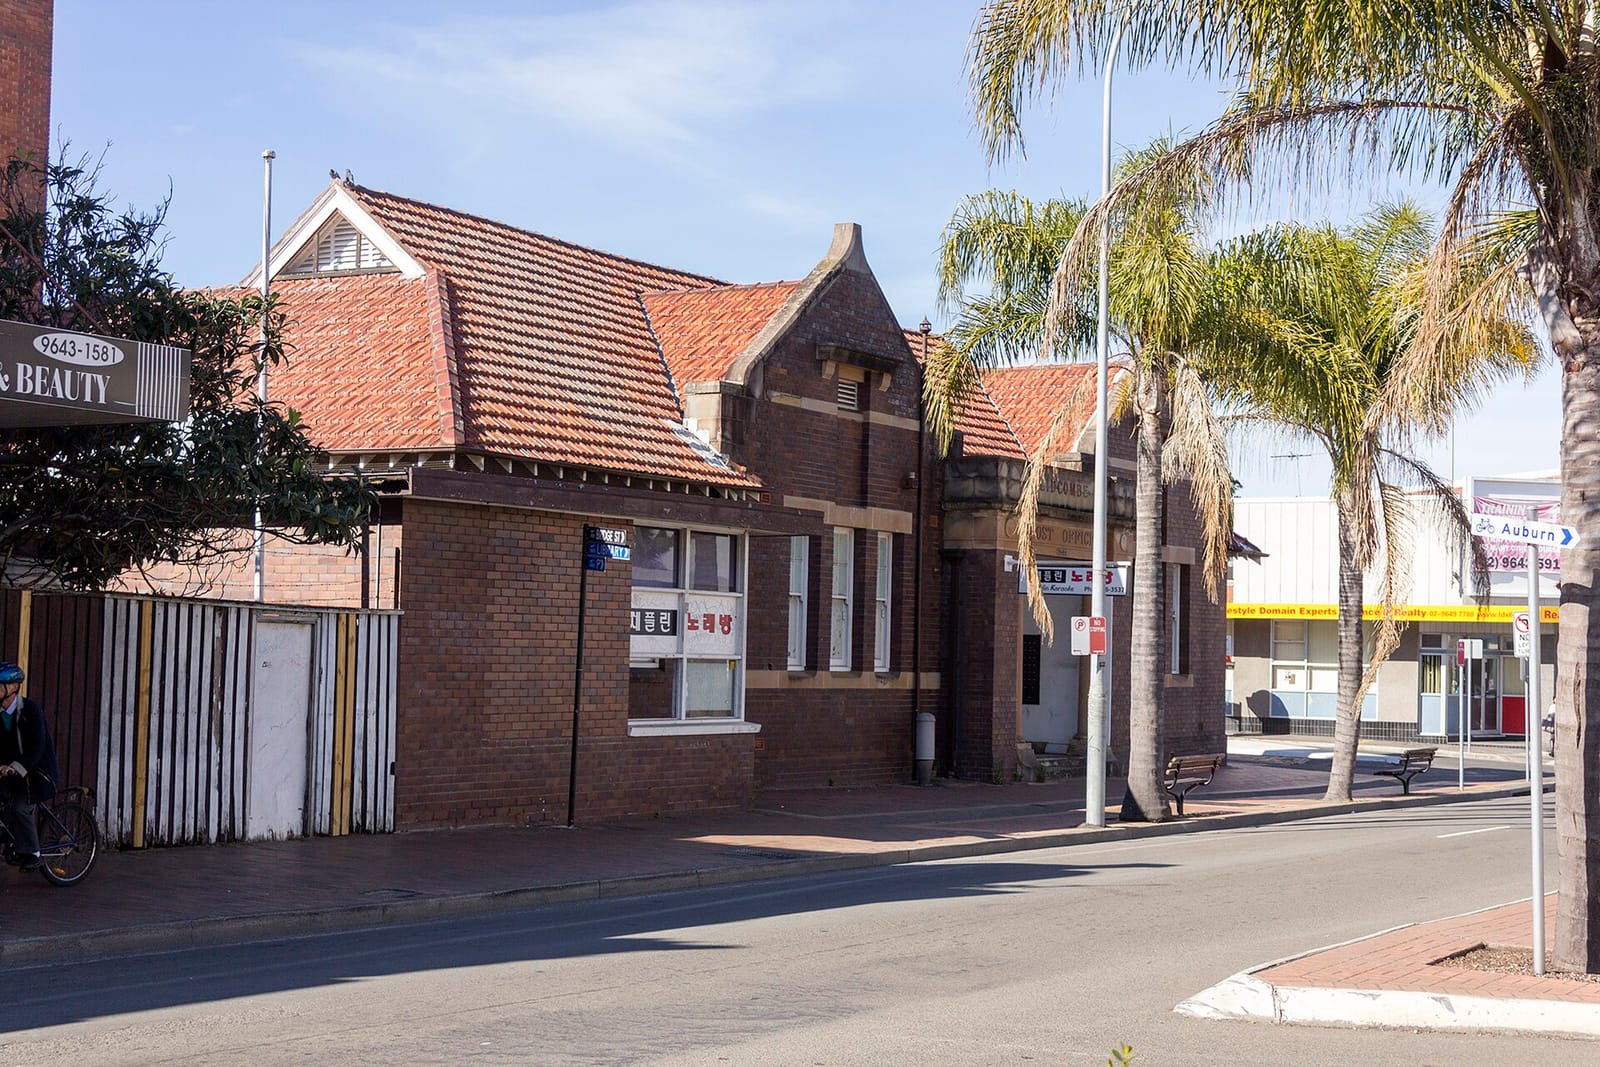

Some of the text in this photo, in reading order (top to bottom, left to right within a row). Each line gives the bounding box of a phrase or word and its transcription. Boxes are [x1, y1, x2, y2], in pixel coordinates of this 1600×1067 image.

[41, 336, 117, 363] 9643-1581
[15, 362, 111, 405] BEAUTY
[1501, 523, 1555, 541] Auburn
[1259, 606, 1296, 615] Domain
[1299, 607, 1337, 616] Experts
[1544, 610, 1560, 619] Re
[687, 612, 733, 635] 노래방
